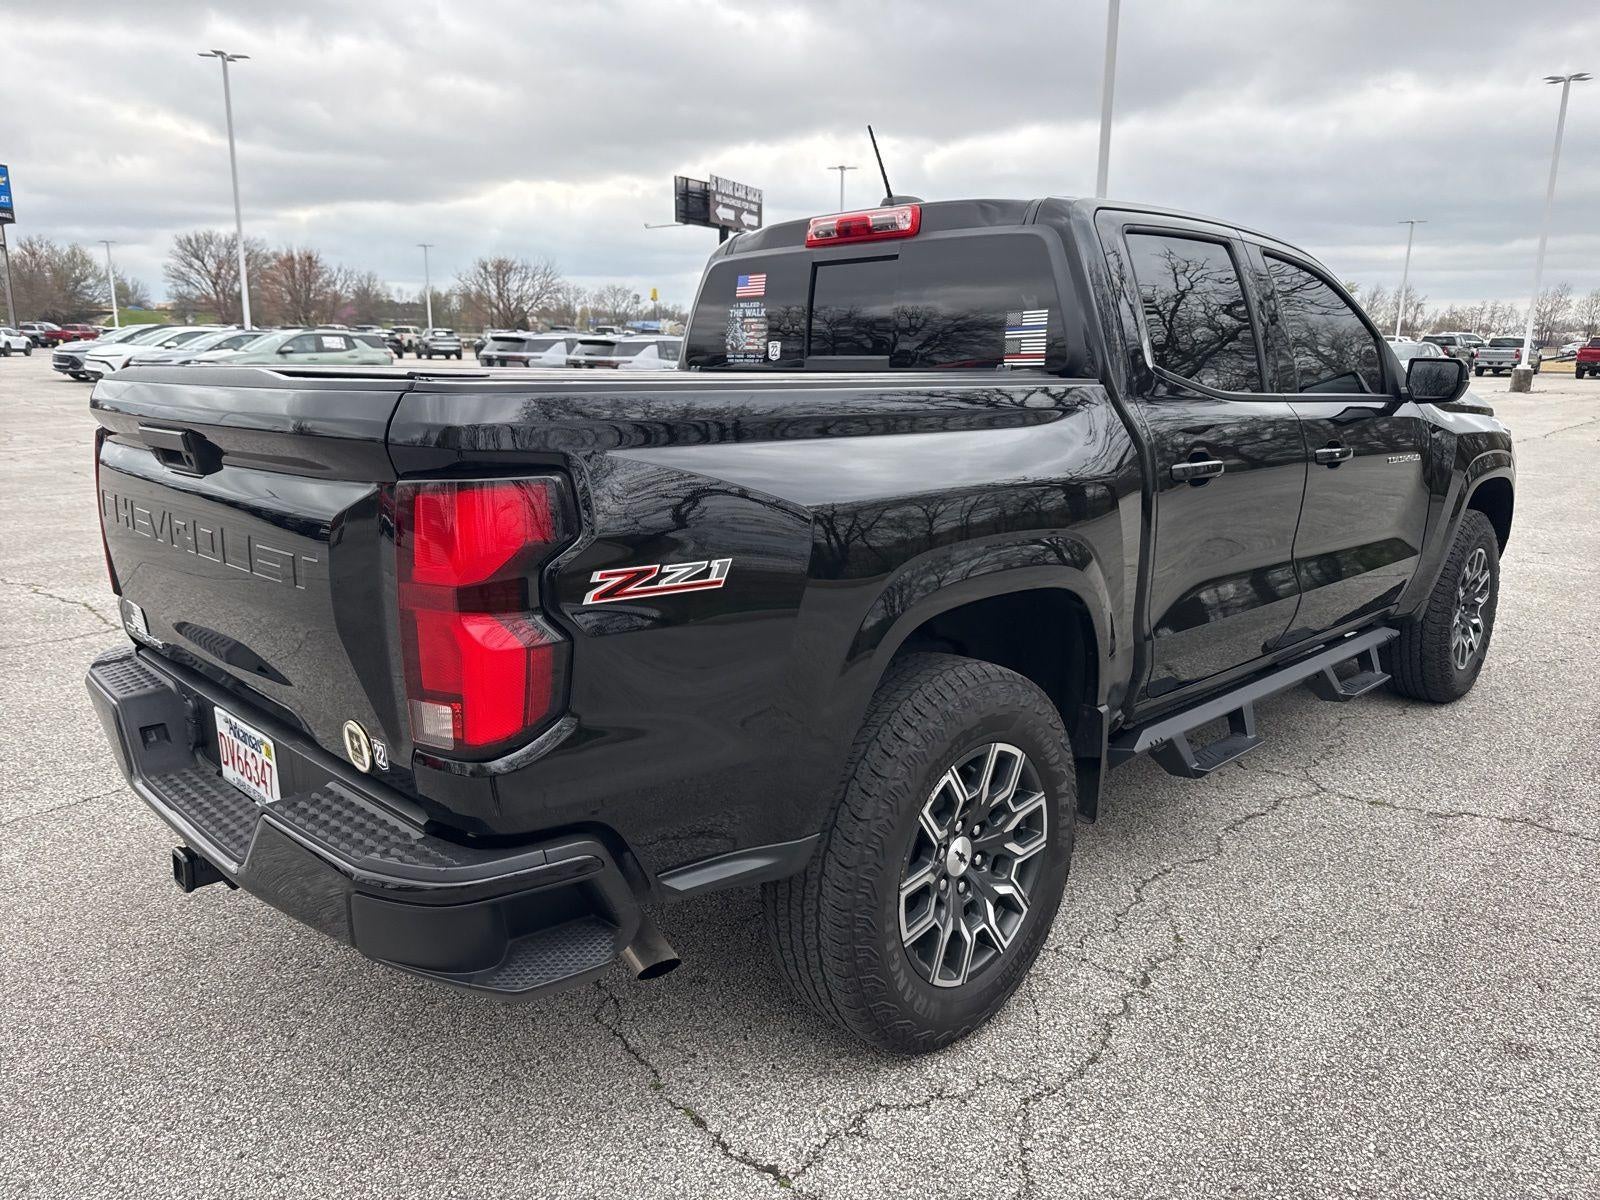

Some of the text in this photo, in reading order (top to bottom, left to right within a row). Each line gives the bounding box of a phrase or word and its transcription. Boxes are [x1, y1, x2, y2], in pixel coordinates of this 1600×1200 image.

[730, 308, 766, 318] THE WALK
[101, 488, 319, 590] CHEVROLET
[583, 558, 732, 605] Z71
[229, 718, 262, 755] Arkansas
[219, 731, 275, 800] DV66347
